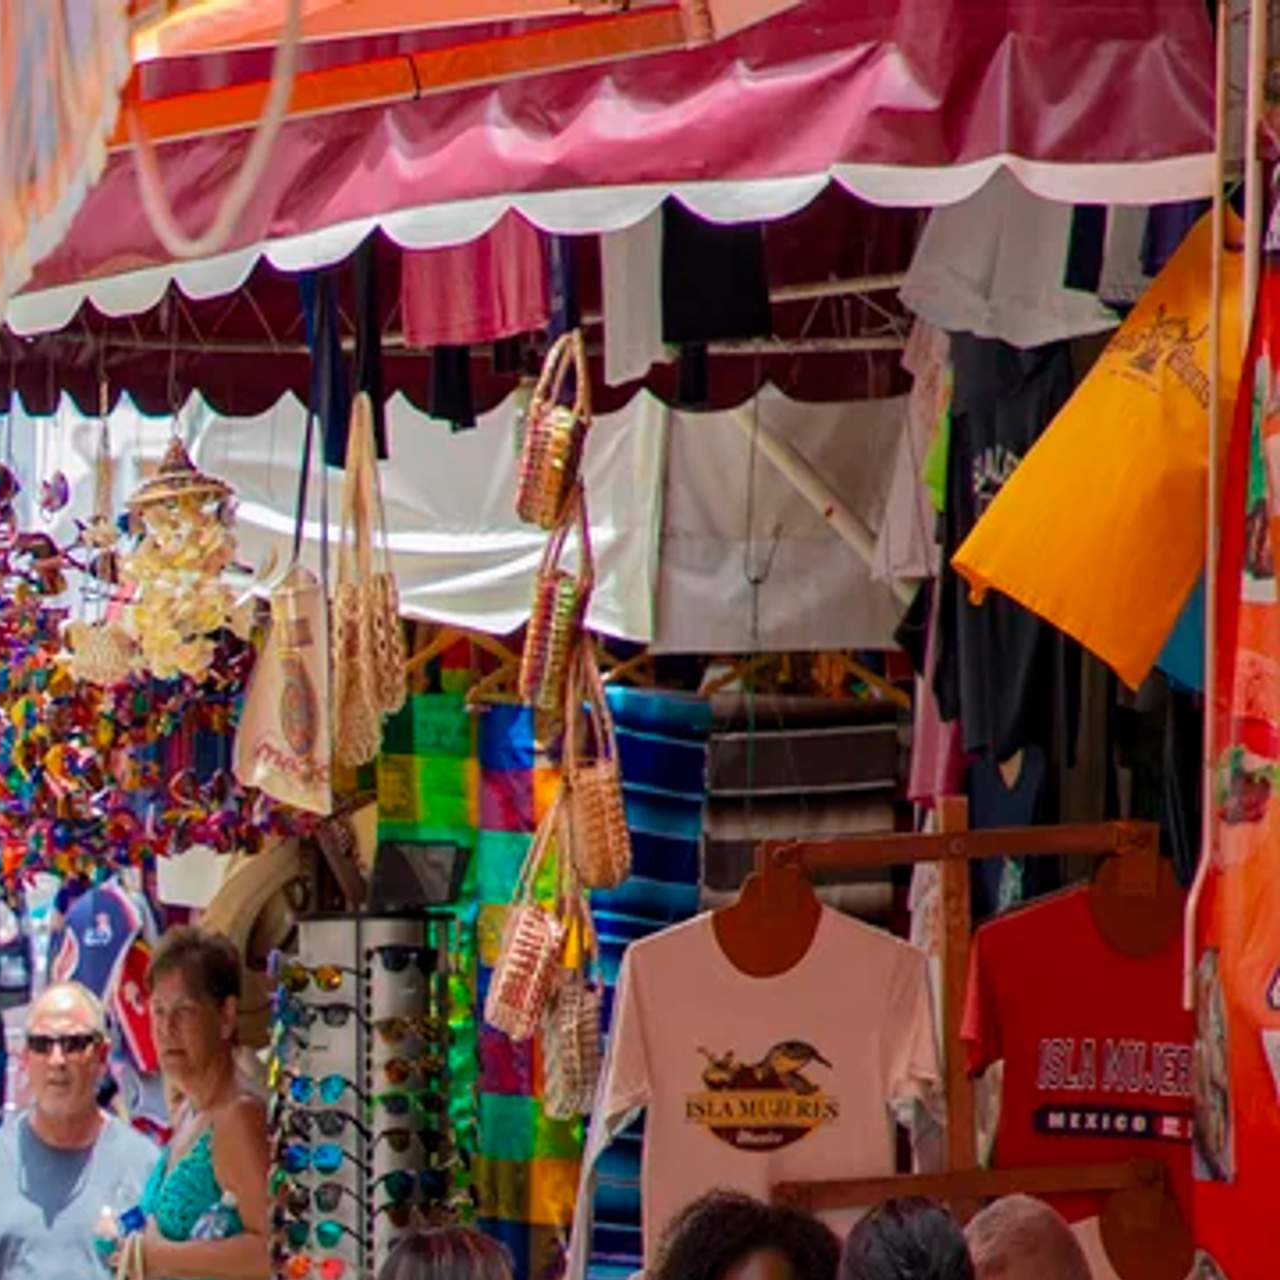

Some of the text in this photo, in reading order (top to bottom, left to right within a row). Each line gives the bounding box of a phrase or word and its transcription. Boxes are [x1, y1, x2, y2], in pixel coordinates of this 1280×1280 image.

[1038, 1037, 1097, 1091] ISLA
[685, 1099, 734, 1120] ISLA
[1047, 1110, 1147, 1134] MEXICO
